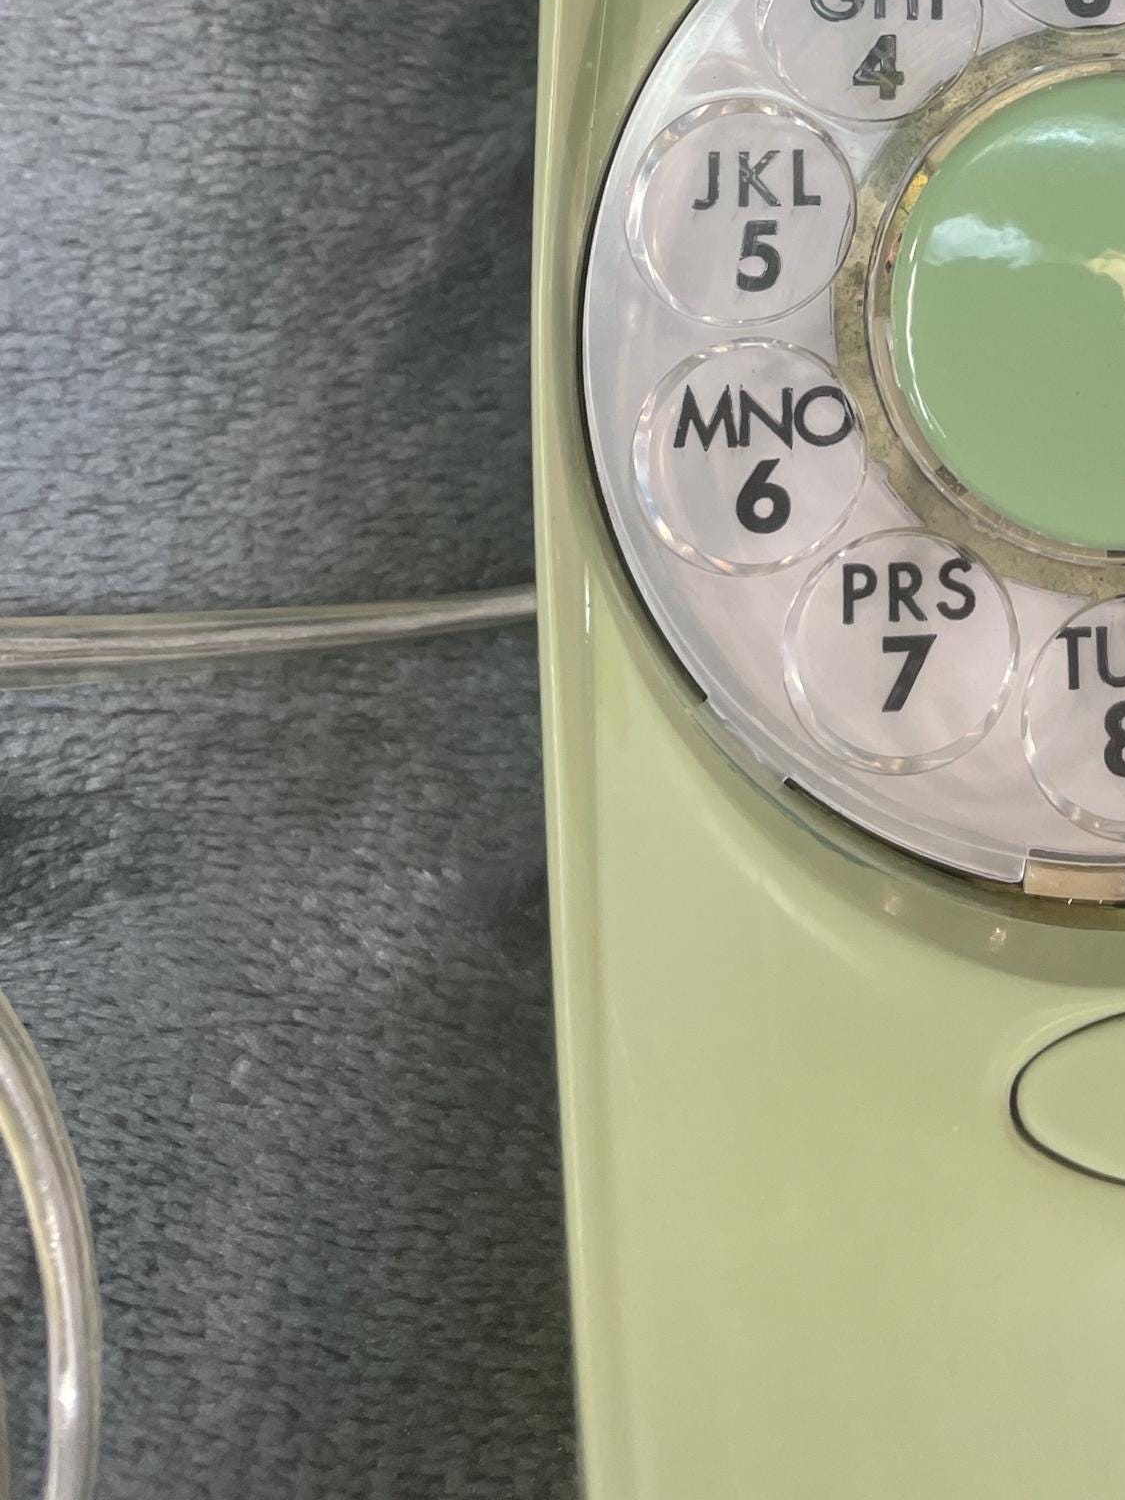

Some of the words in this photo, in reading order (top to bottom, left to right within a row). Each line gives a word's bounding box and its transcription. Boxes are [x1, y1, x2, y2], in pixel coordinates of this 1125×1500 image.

[852, 34, 905, 100] 4
[691, 148, 822, 211] JKL
[736, 219, 781, 292] 5
[673, 384, 855, 451] MNO
[735, 458, 791, 534] 6
[841, 557, 976, 625] PRS
[881, 633, 938, 713] 7
